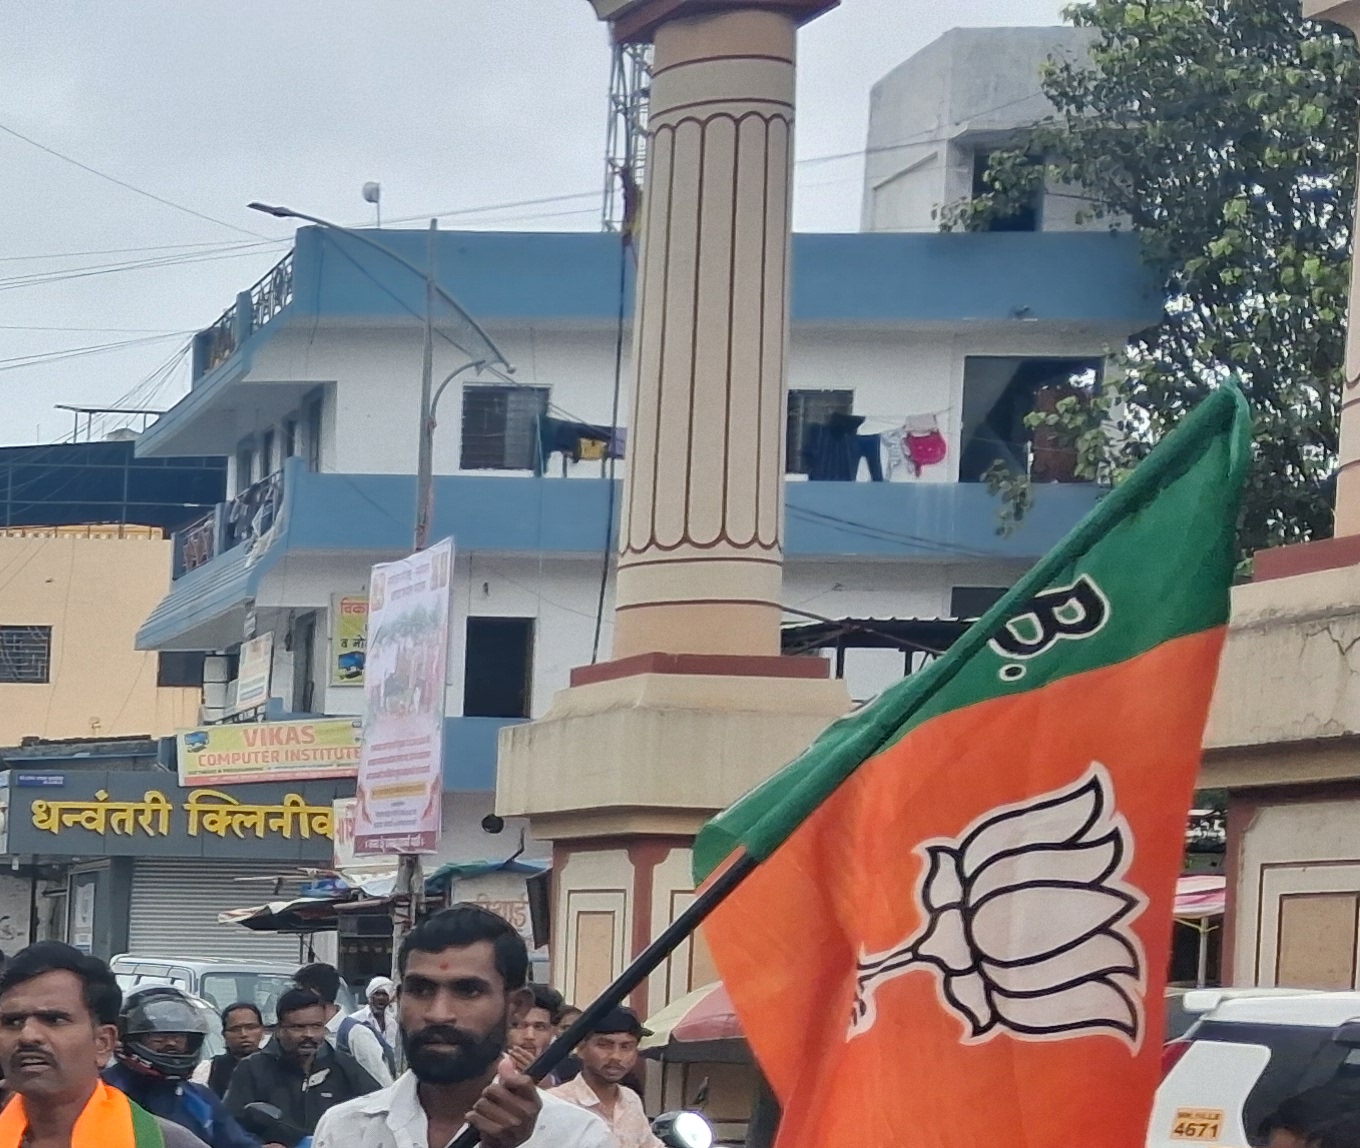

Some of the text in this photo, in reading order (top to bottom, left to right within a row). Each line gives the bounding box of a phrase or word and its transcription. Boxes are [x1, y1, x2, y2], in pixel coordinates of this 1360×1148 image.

[243, 725, 316, 748] VIKAS
[198, 750, 279, 767] COMPUTER
[31, 789, 173, 838] धन्वंतरी
[1174, 1122, 1218, 1137] 4671
